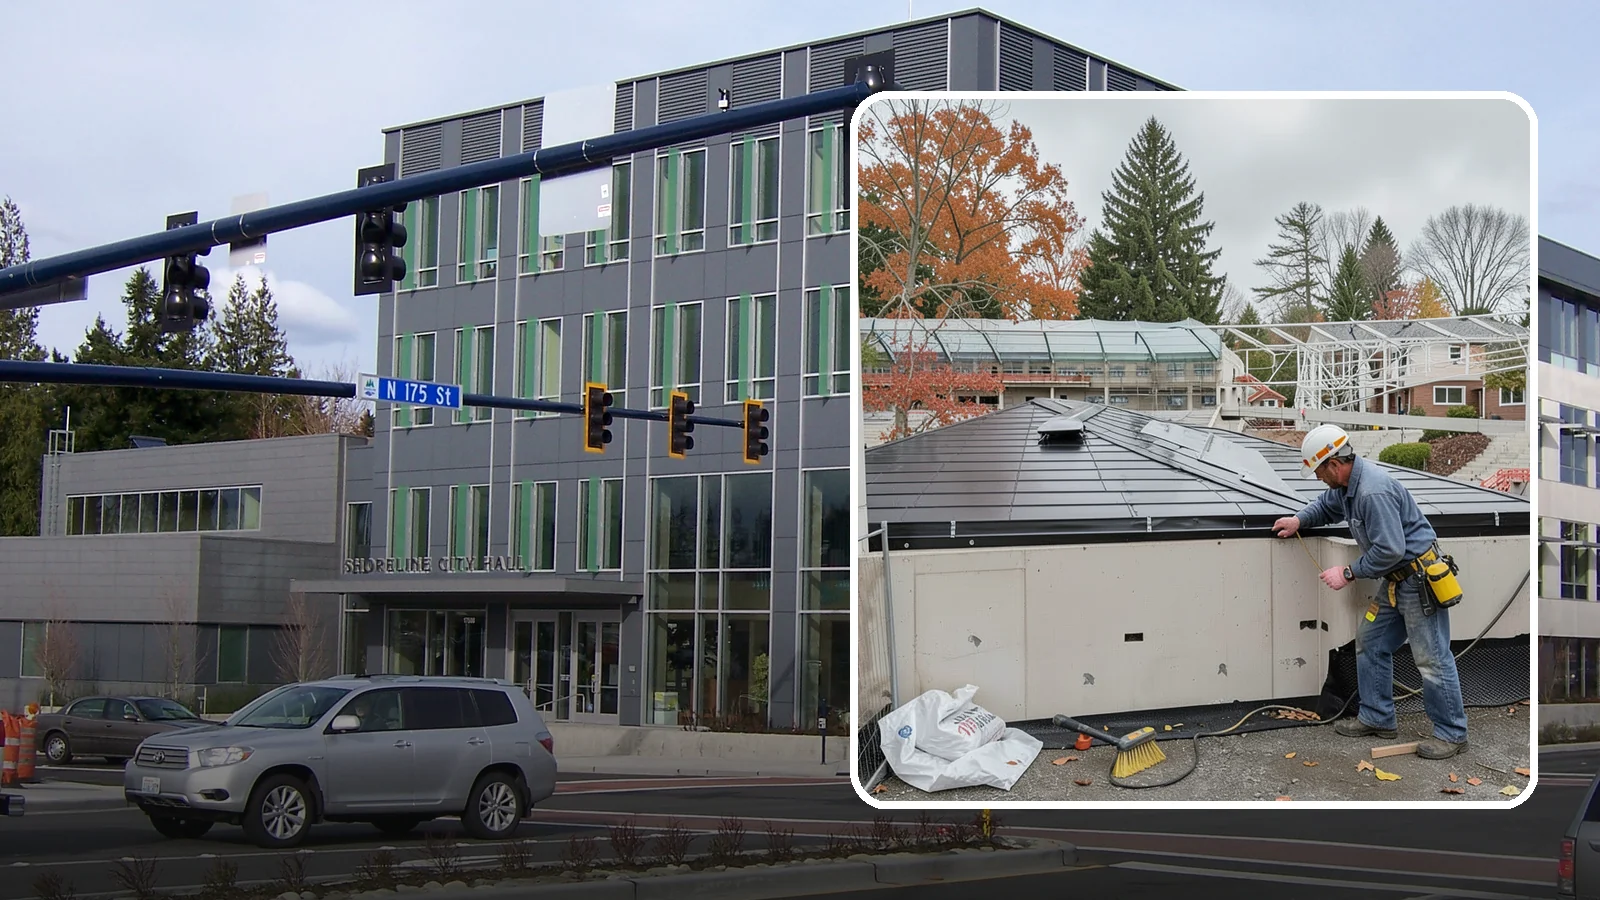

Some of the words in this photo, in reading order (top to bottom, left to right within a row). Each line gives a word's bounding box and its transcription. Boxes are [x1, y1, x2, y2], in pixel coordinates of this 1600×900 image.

[387, 380, 396, 400] N
[405, 383, 428, 403] 175
[436, 386, 452, 406] St
[343, 556, 433, 574] SHORELINE
[438, 555, 476, 573] CITY
[483, 555, 527, 573] HALL
